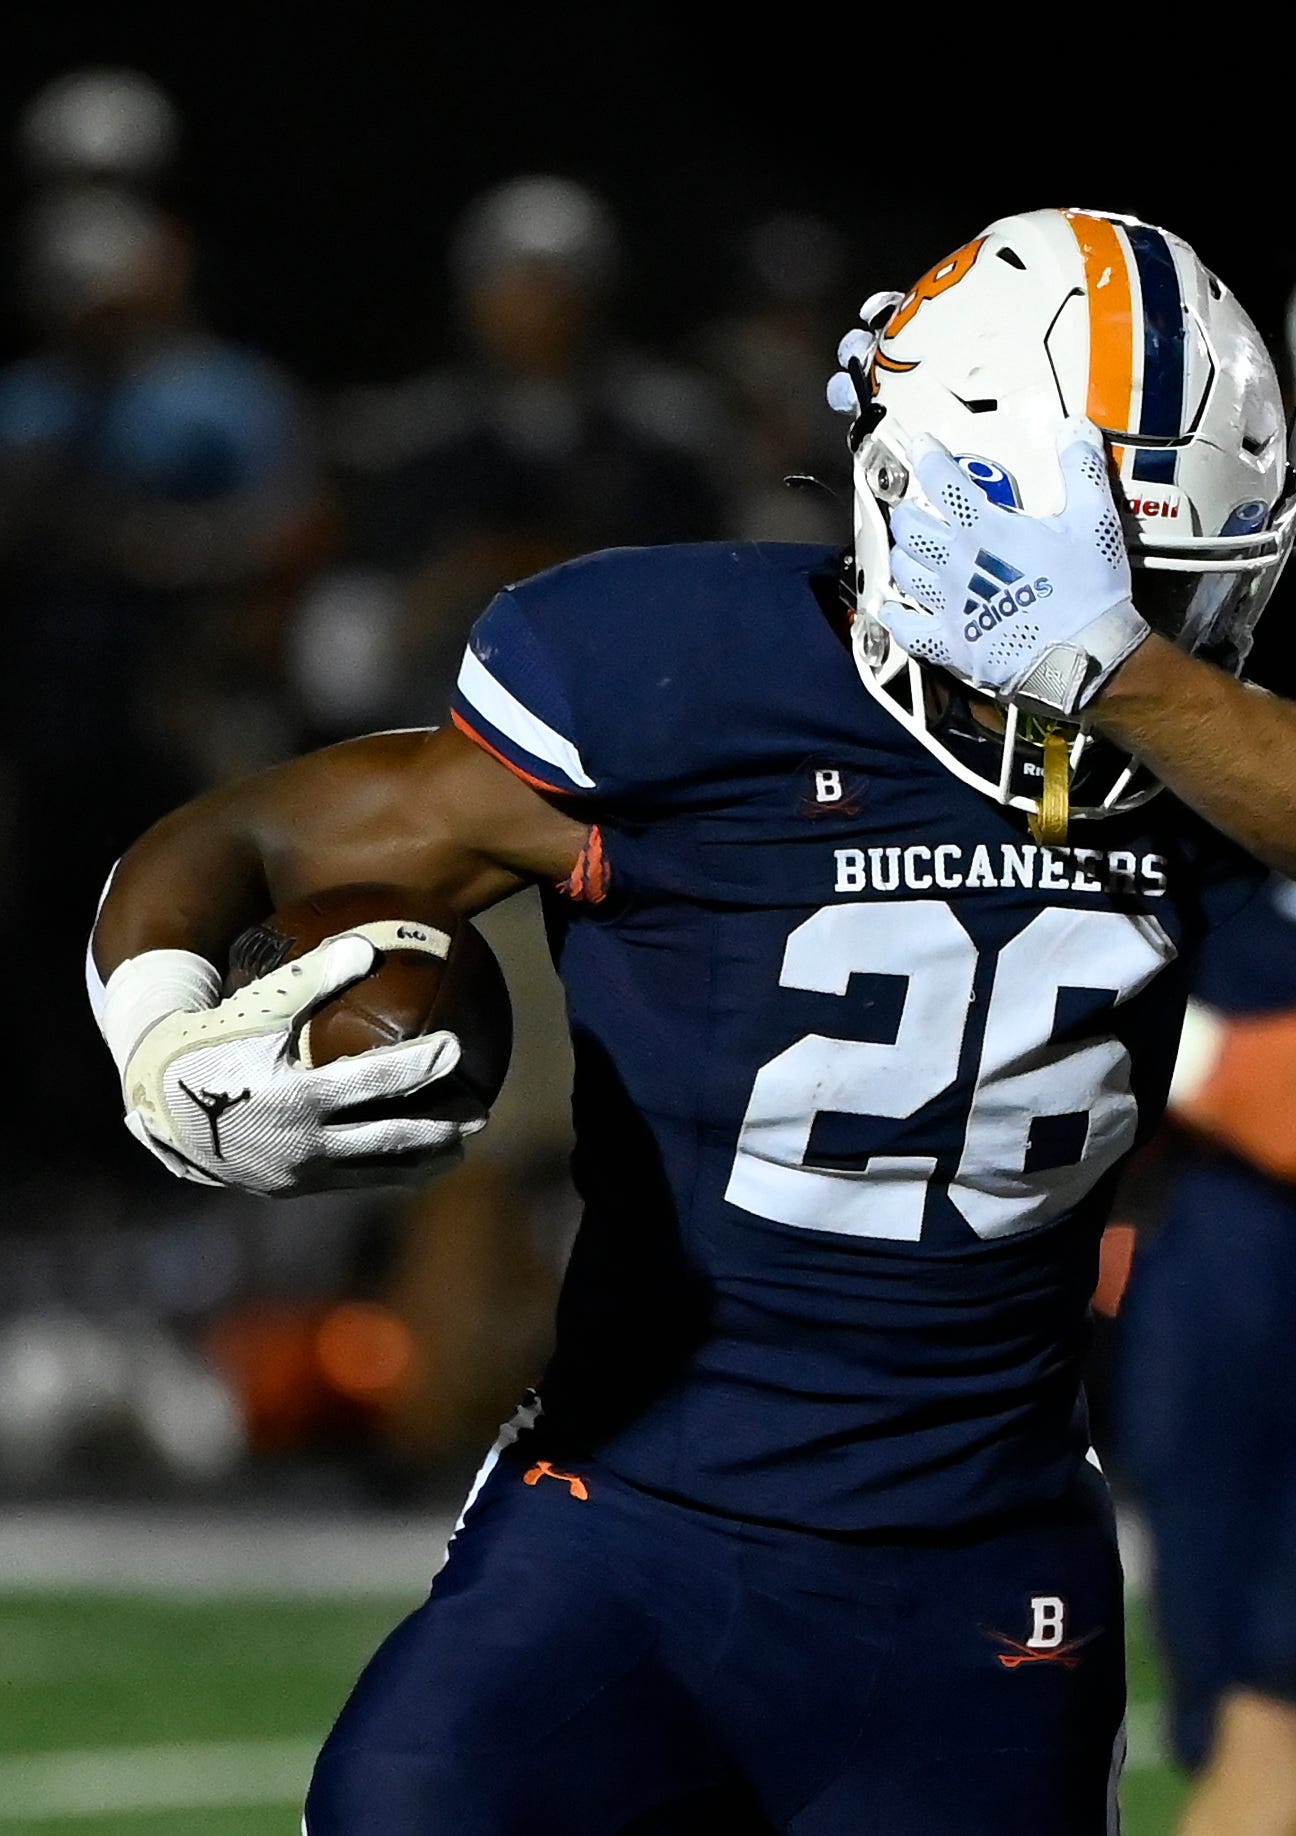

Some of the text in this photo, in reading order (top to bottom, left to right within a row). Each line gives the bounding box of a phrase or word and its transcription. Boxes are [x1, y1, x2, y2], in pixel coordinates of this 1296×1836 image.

[1117, 496, 1180, 518] dell
[964, 576, 1053, 642] adidas
[815, 770, 842, 802] B
[833, 844, 1167, 896] BUCCANEERS
[724, 899, 1178, 1242] 26
[1026, 1596, 1064, 1648] B
